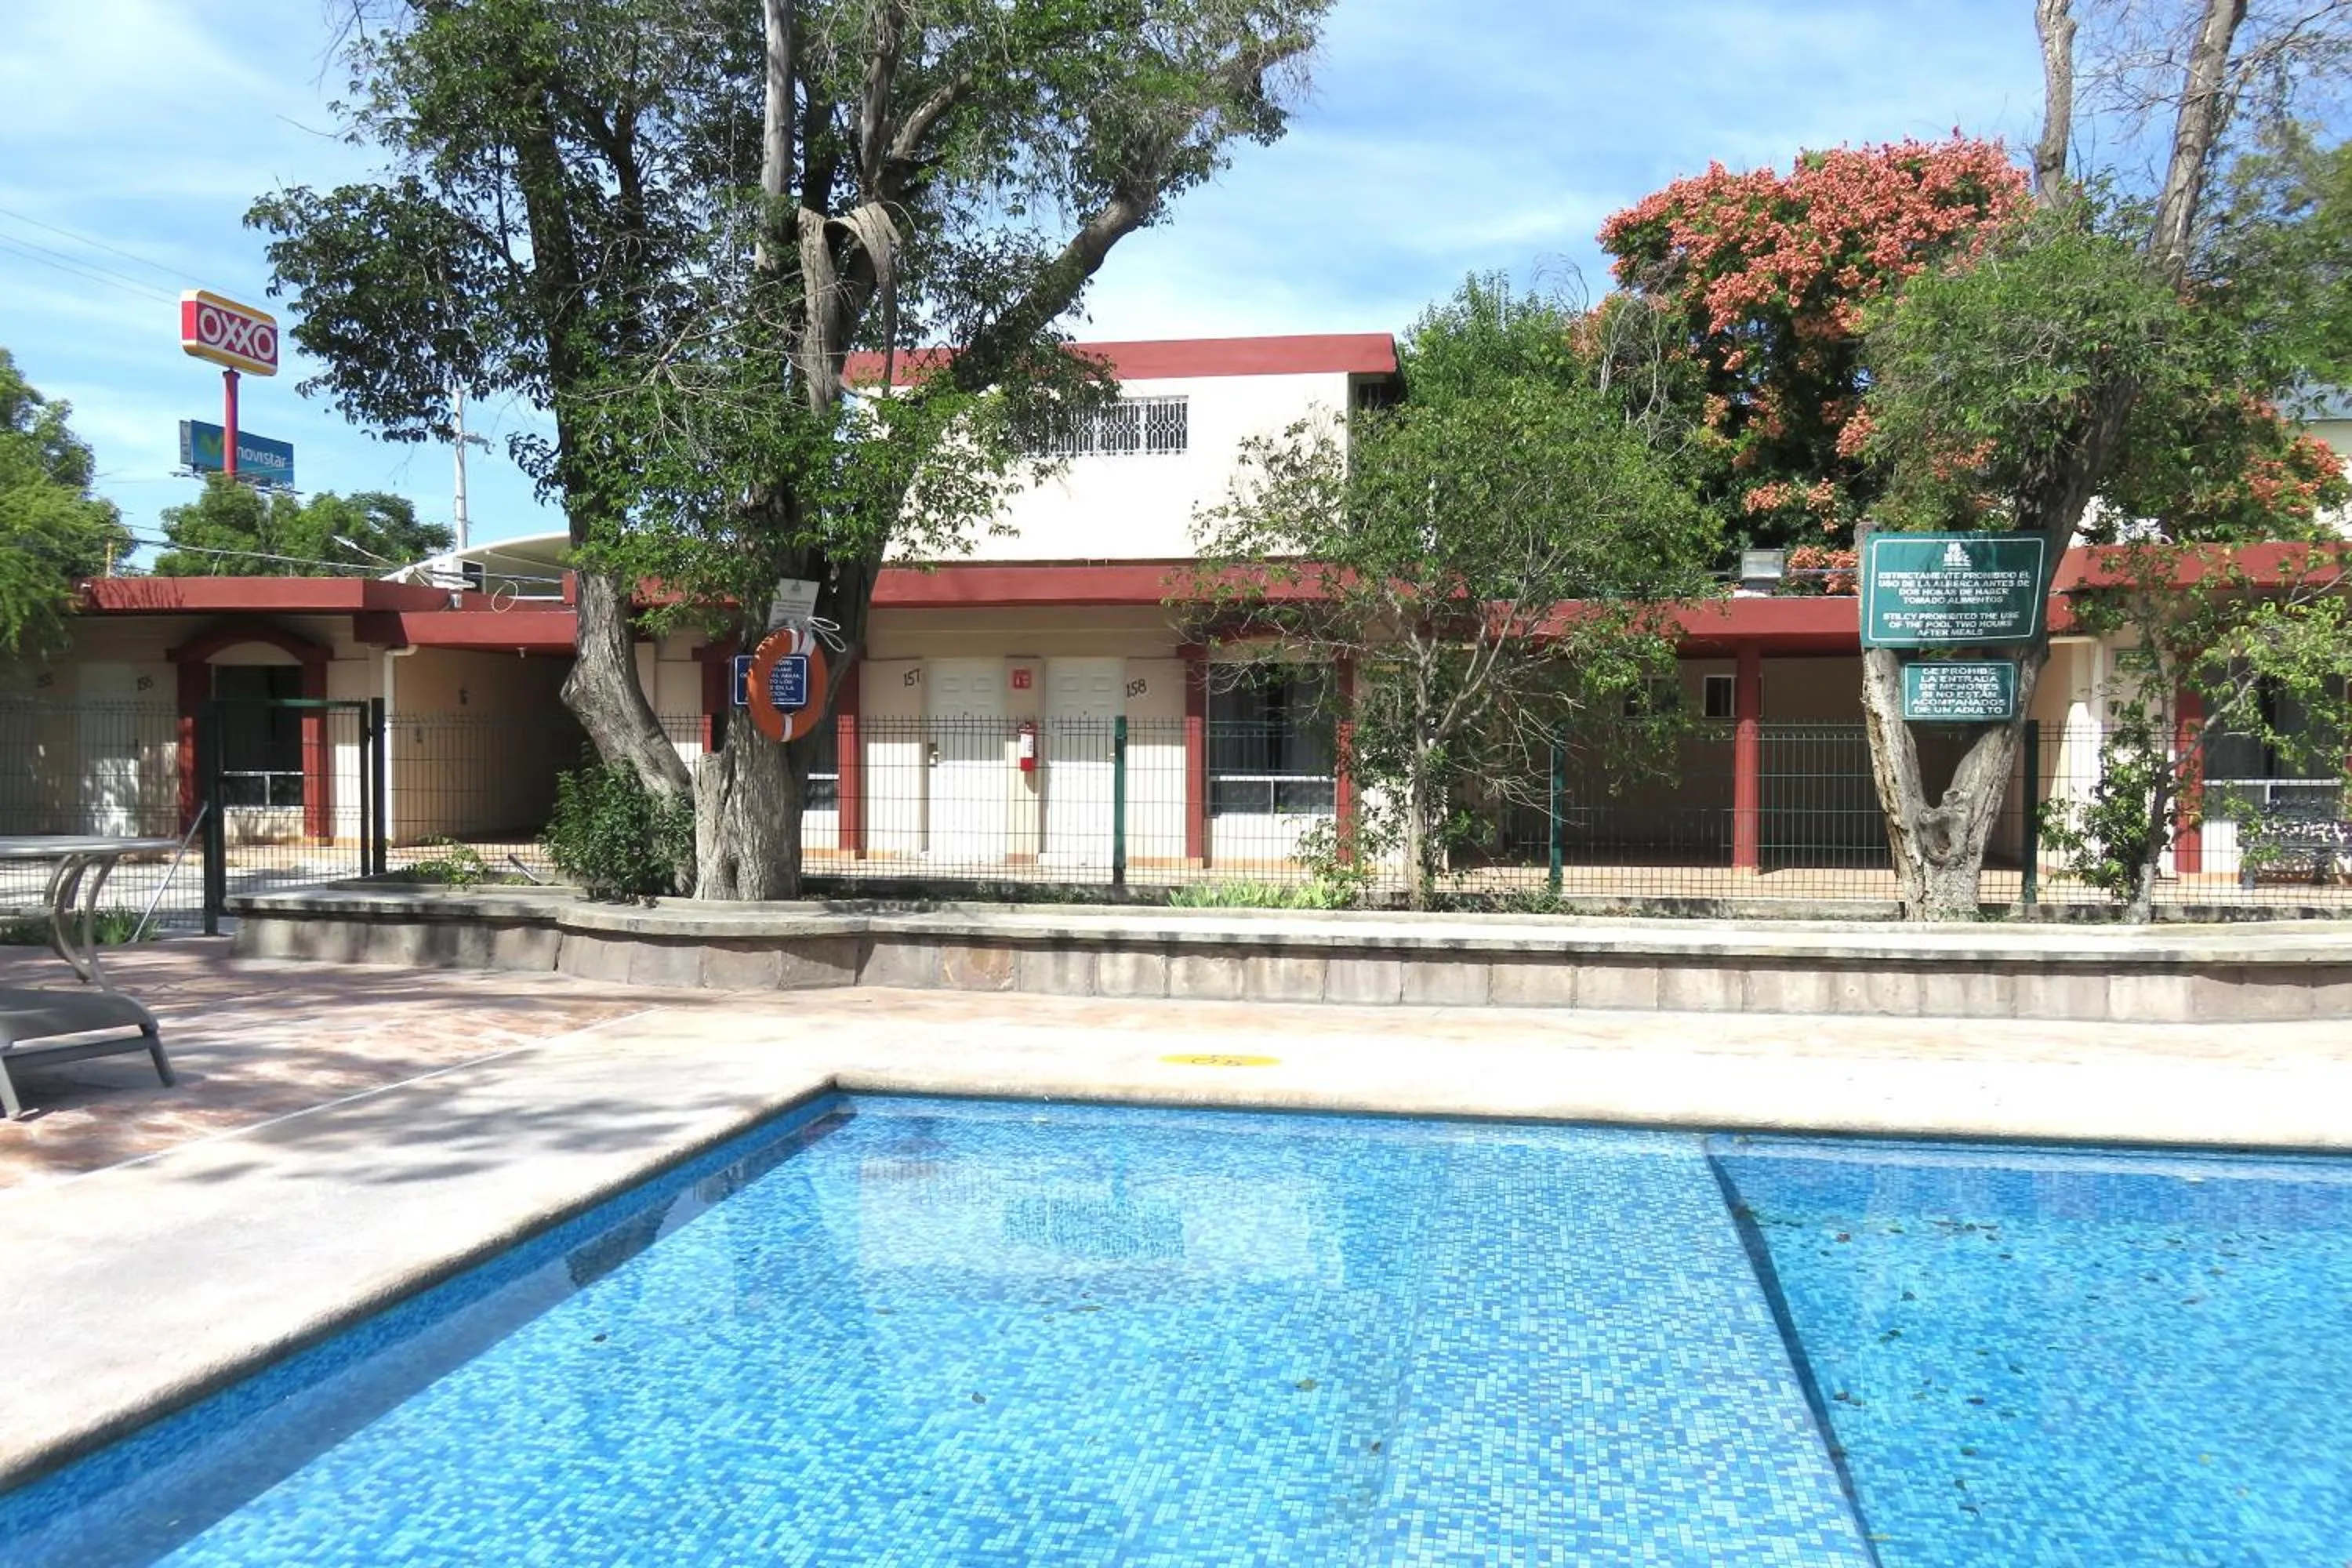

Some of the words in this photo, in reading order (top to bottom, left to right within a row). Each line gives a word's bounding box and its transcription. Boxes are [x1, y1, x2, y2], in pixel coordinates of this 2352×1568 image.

[198, 307, 275, 361] OXXO
[2000, 611, 2020, 620] USE
[904, 667, 921, 688] 157
[1126, 678, 1147, 698] 158
